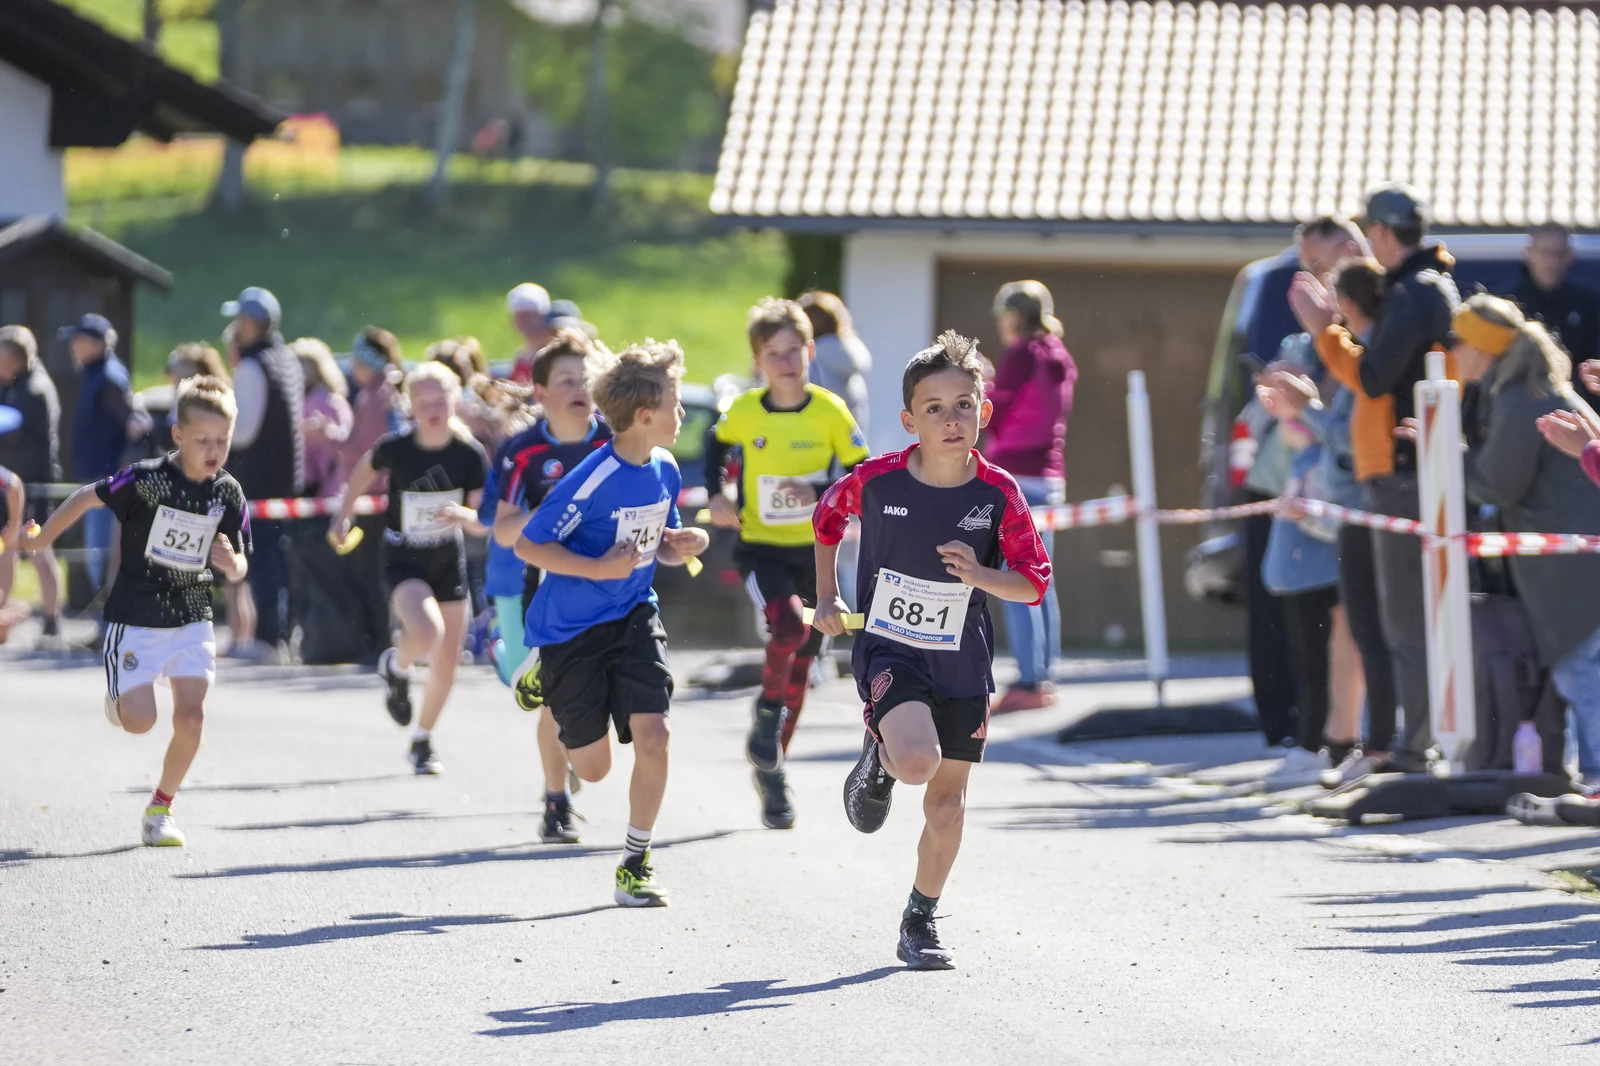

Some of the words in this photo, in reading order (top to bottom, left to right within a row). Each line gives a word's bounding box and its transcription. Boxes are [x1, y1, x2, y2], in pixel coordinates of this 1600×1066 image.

[883, 505, 908, 516] JAKO
[163, 527, 204, 553] 52-1
[903, 578, 930, 589] Volksbank
[888, 597, 950, 630] 68-1
[905, 629, 943, 641] Voralpencup
